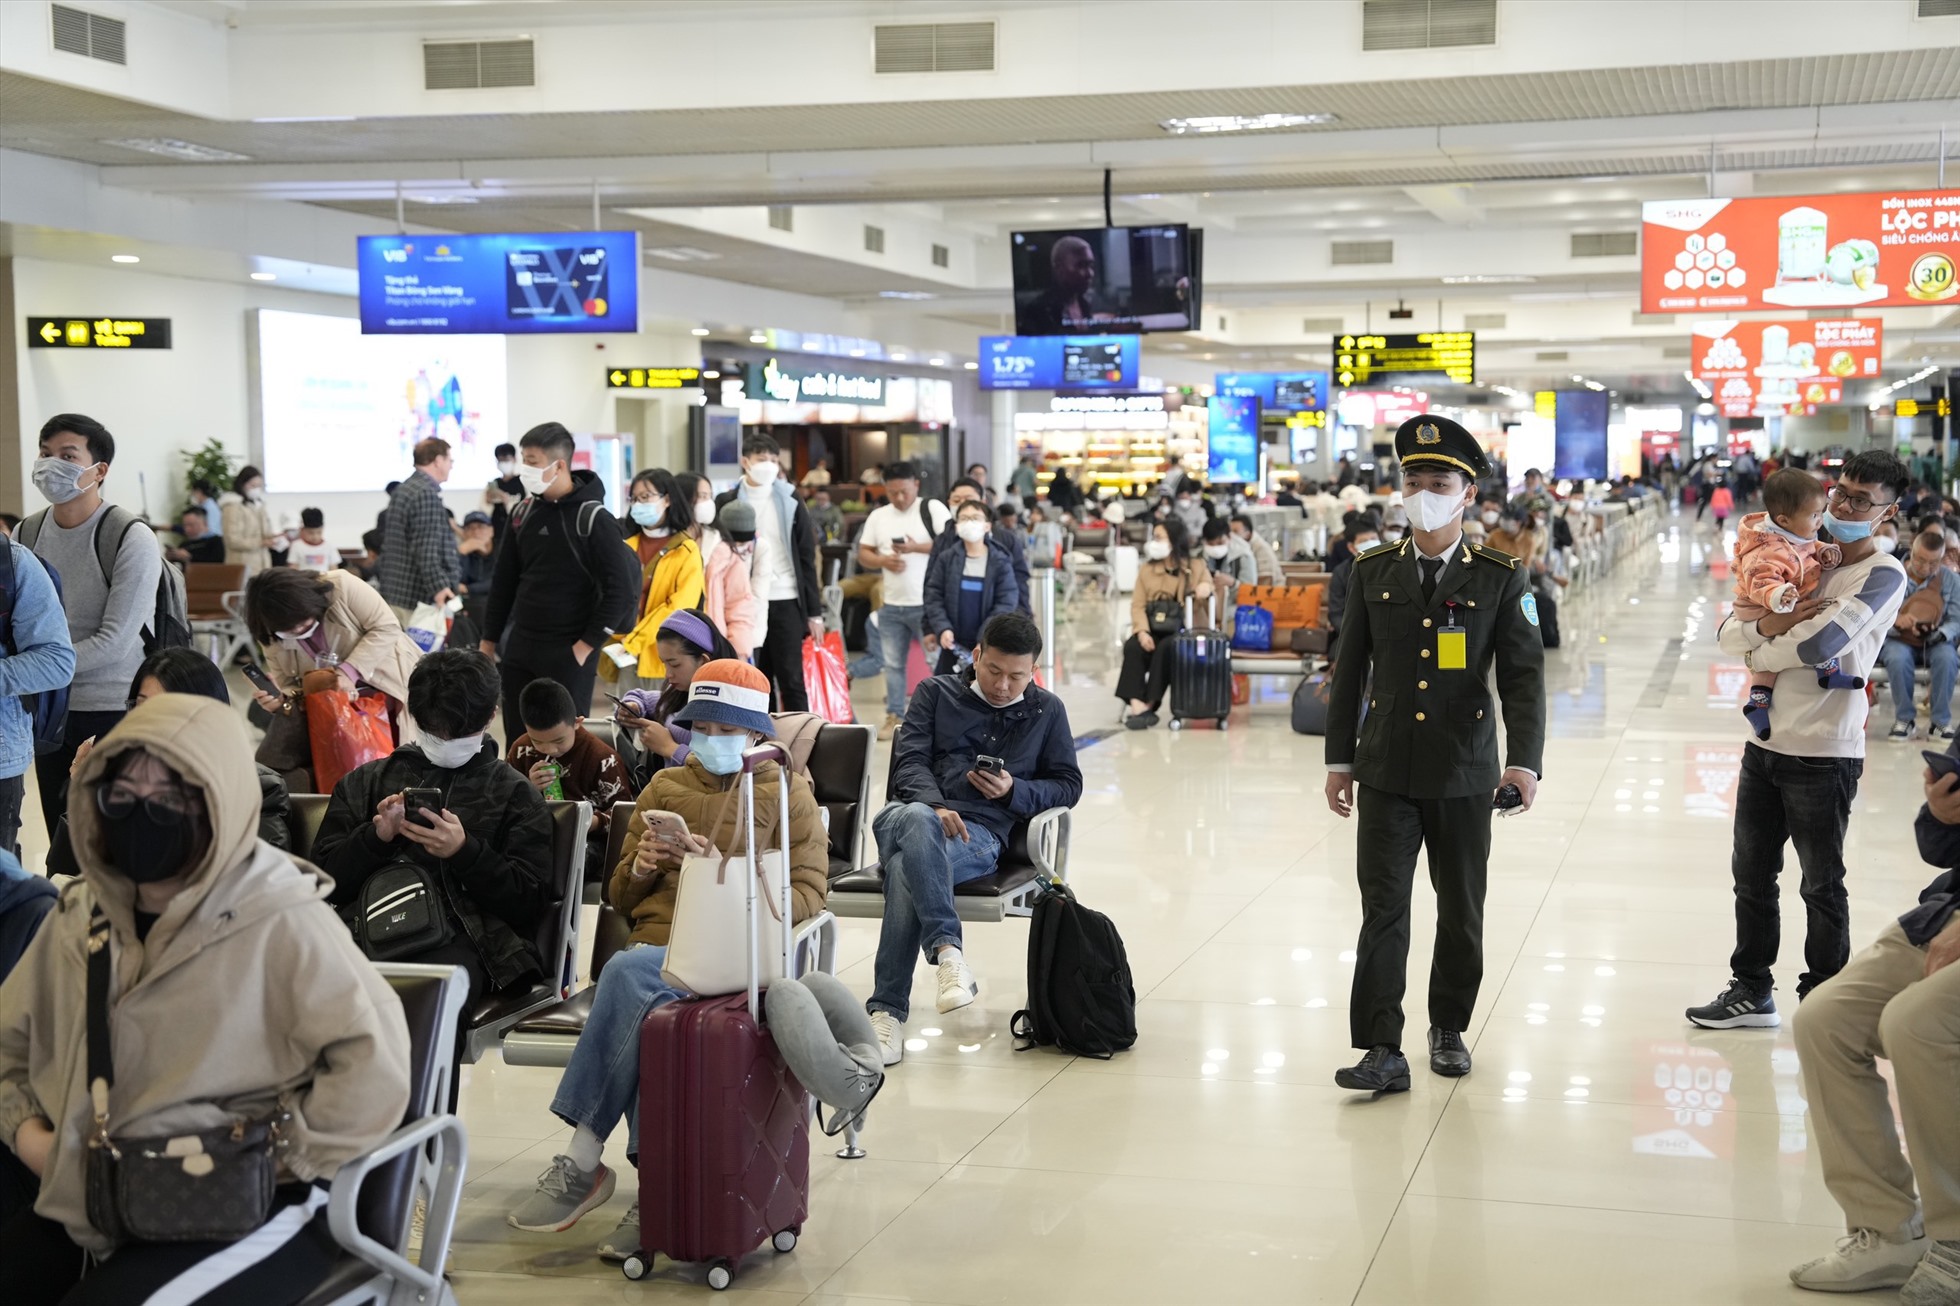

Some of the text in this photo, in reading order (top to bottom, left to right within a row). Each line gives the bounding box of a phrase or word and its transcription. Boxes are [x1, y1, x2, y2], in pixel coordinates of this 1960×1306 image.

[1907, 198, 1933, 208] INOX
[1881, 209, 1928, 234] LỘC
[383, 249, 408, 263] VIB
[579, 254, 599, 265] VIB
[1921, 267, 1947, 283] 30
[1841, 325, 1876, 339] PHÁT
